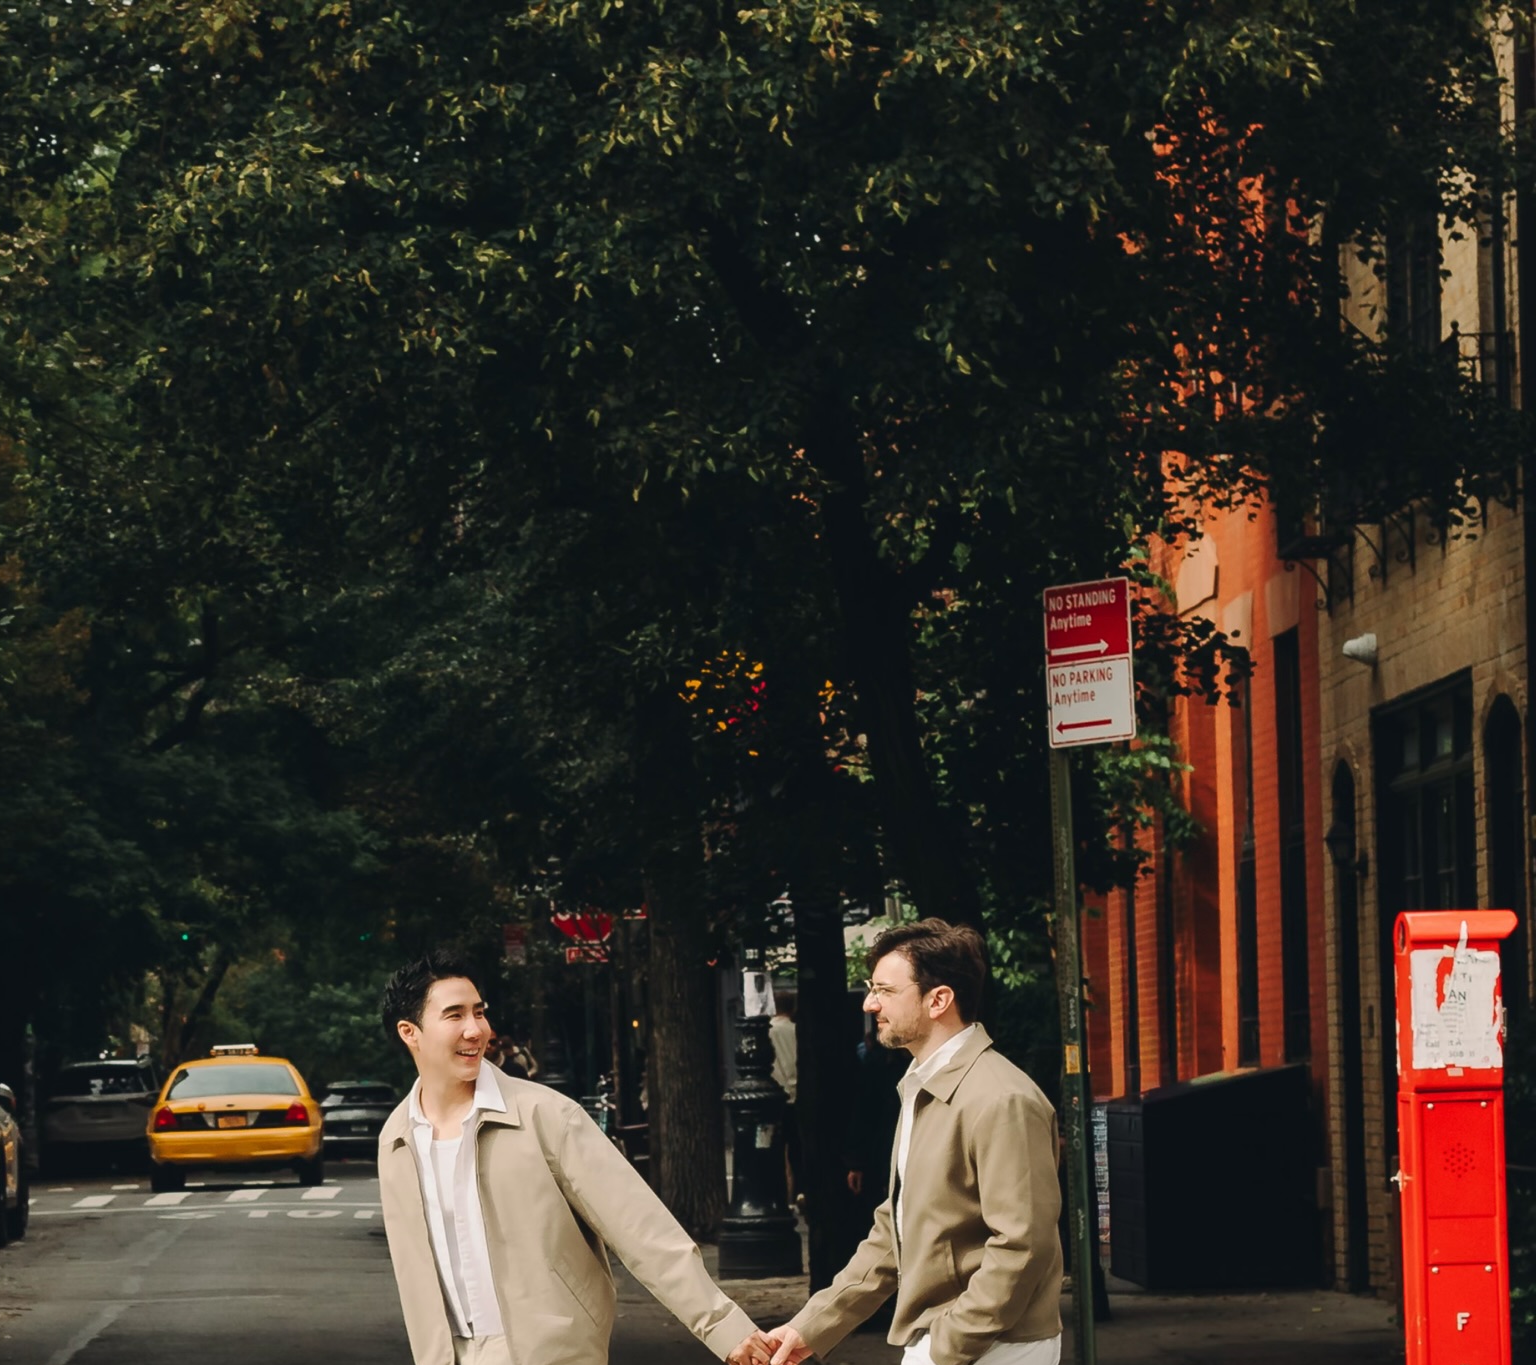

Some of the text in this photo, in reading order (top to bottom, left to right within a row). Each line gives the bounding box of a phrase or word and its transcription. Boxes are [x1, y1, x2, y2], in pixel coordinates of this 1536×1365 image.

[1049, 589, 1116, 611] NO STANDING
[1050, 613, 1092, 632] Anytime
[1052, 667, 1113, 687] NO PARKING
[1054, 689, 1096, 707] Anytime
